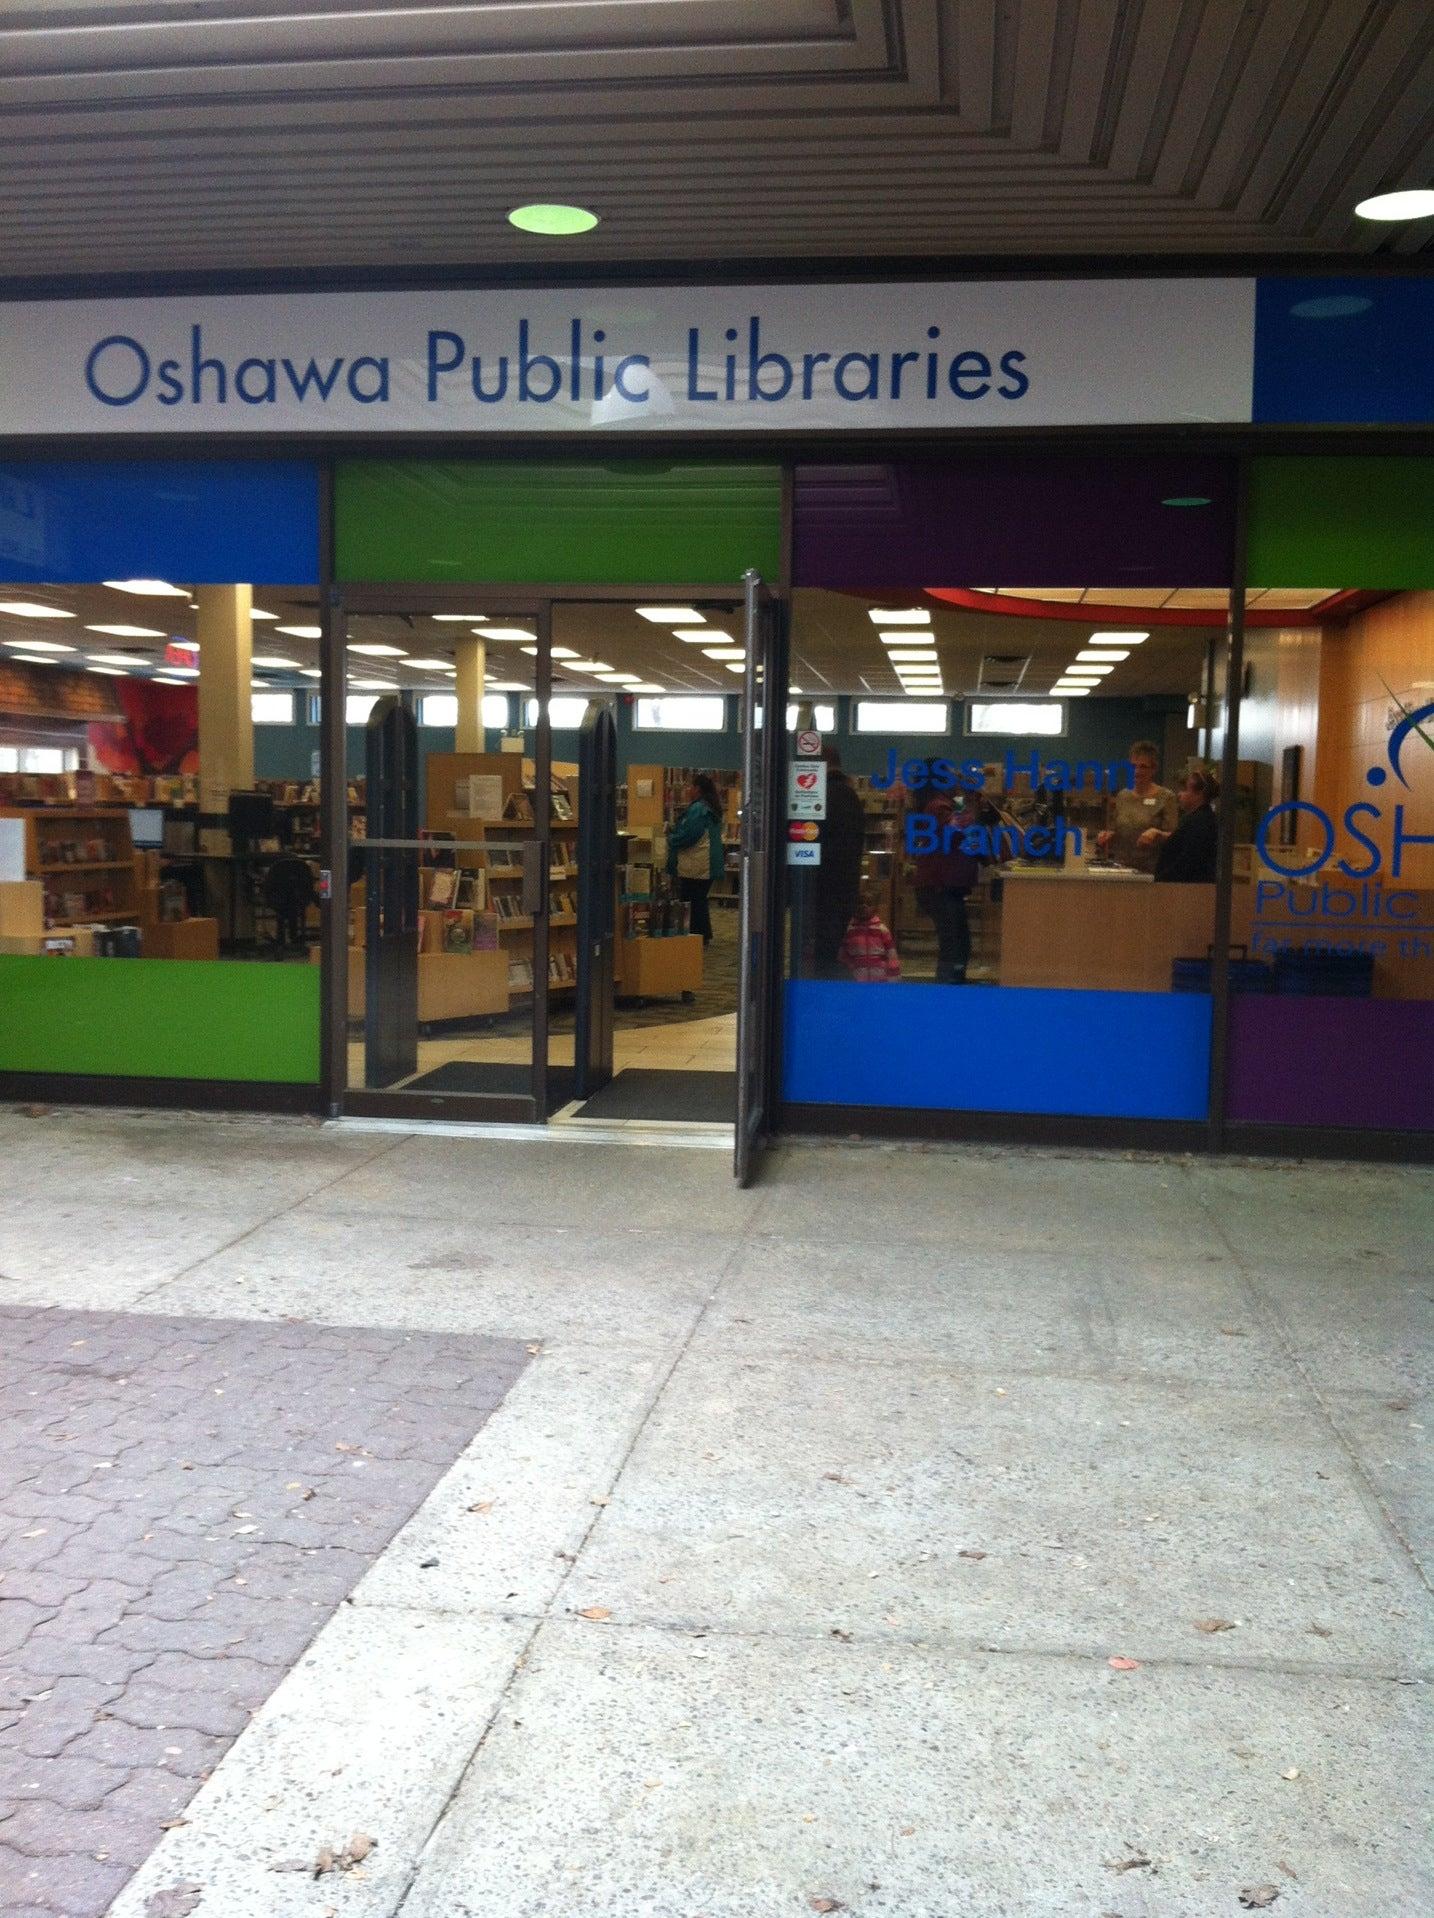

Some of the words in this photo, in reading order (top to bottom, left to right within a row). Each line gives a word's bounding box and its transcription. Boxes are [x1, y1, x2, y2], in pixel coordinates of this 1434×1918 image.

[85, 325, 390, 406] Oshawa
[427, 318, 650, 403] Public
[687, 316, 1030, 401] Libraries
[870, 747, 986, 791] Jess
[1004, 750, 1136, 792] Hann
[795, 850, 814, 858] VISA
[904, 812, 1083, 857] Branch
[1256, 880, 1421, 920] Public
